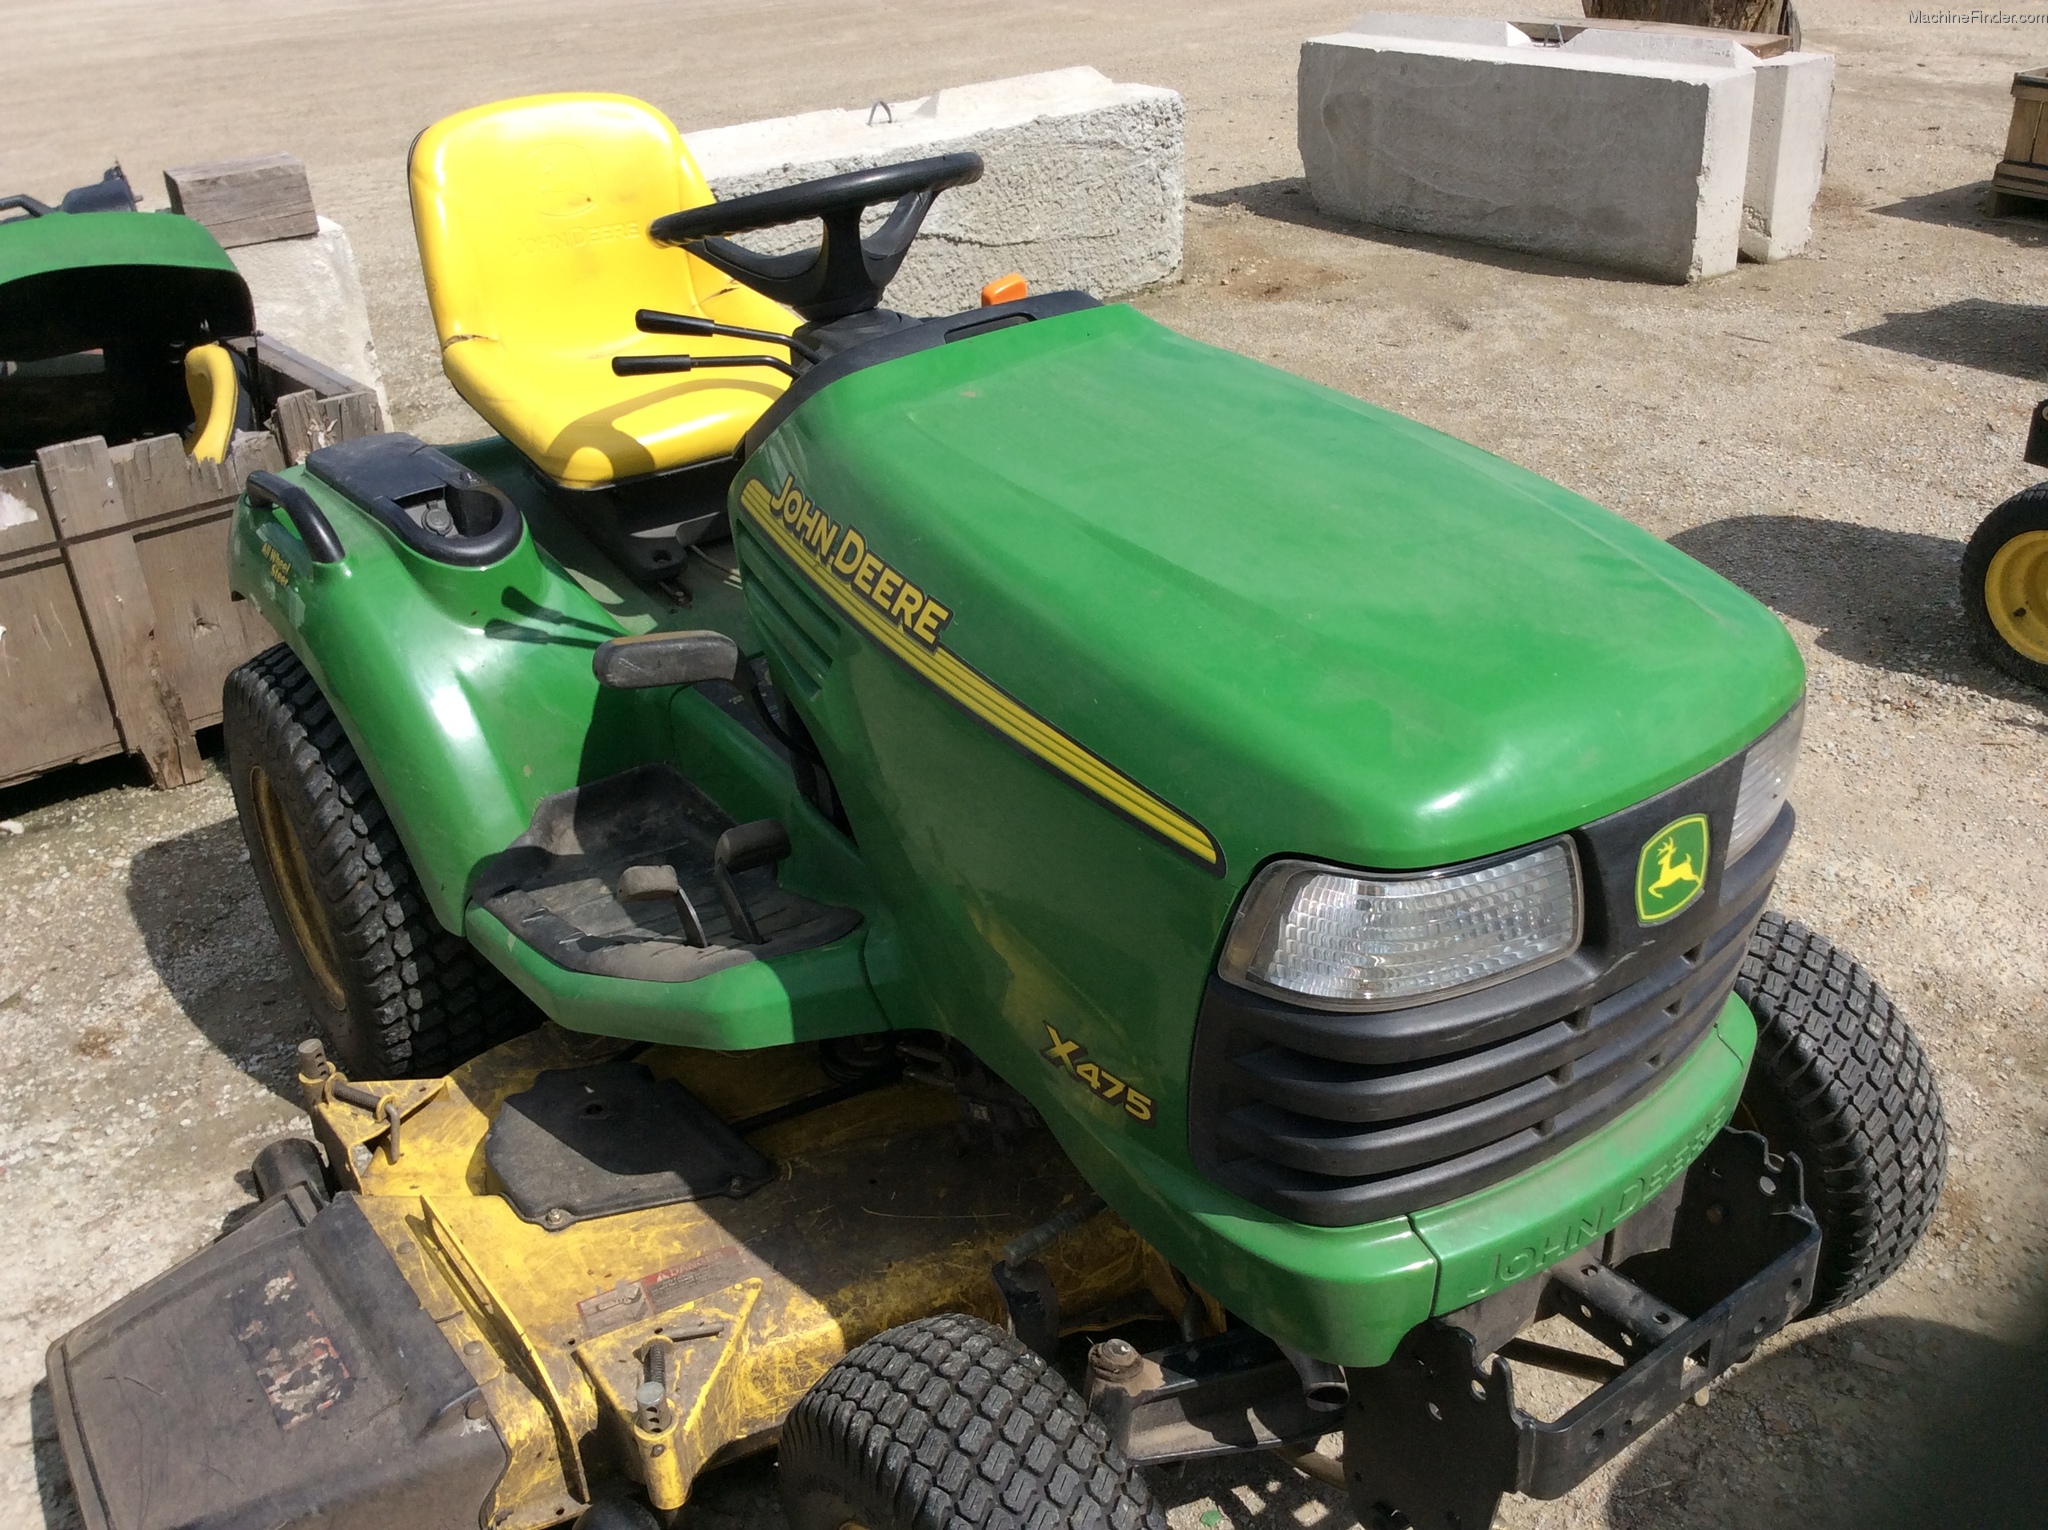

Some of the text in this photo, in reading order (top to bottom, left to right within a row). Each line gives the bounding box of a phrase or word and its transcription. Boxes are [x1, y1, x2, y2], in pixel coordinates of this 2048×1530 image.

[570, 220, 640, 248] DEERE
[270, 548, 292, 575] Wheel
[769, 473, 952, 648] JOHN DEERE
[270, 563, 289, 588] Steer
[1041, 1021, 1155, 1125] X475
[1467, 1105, 1727, 1298] JOHN DEERE
[669, 1251, 724, 1278] DANGER
